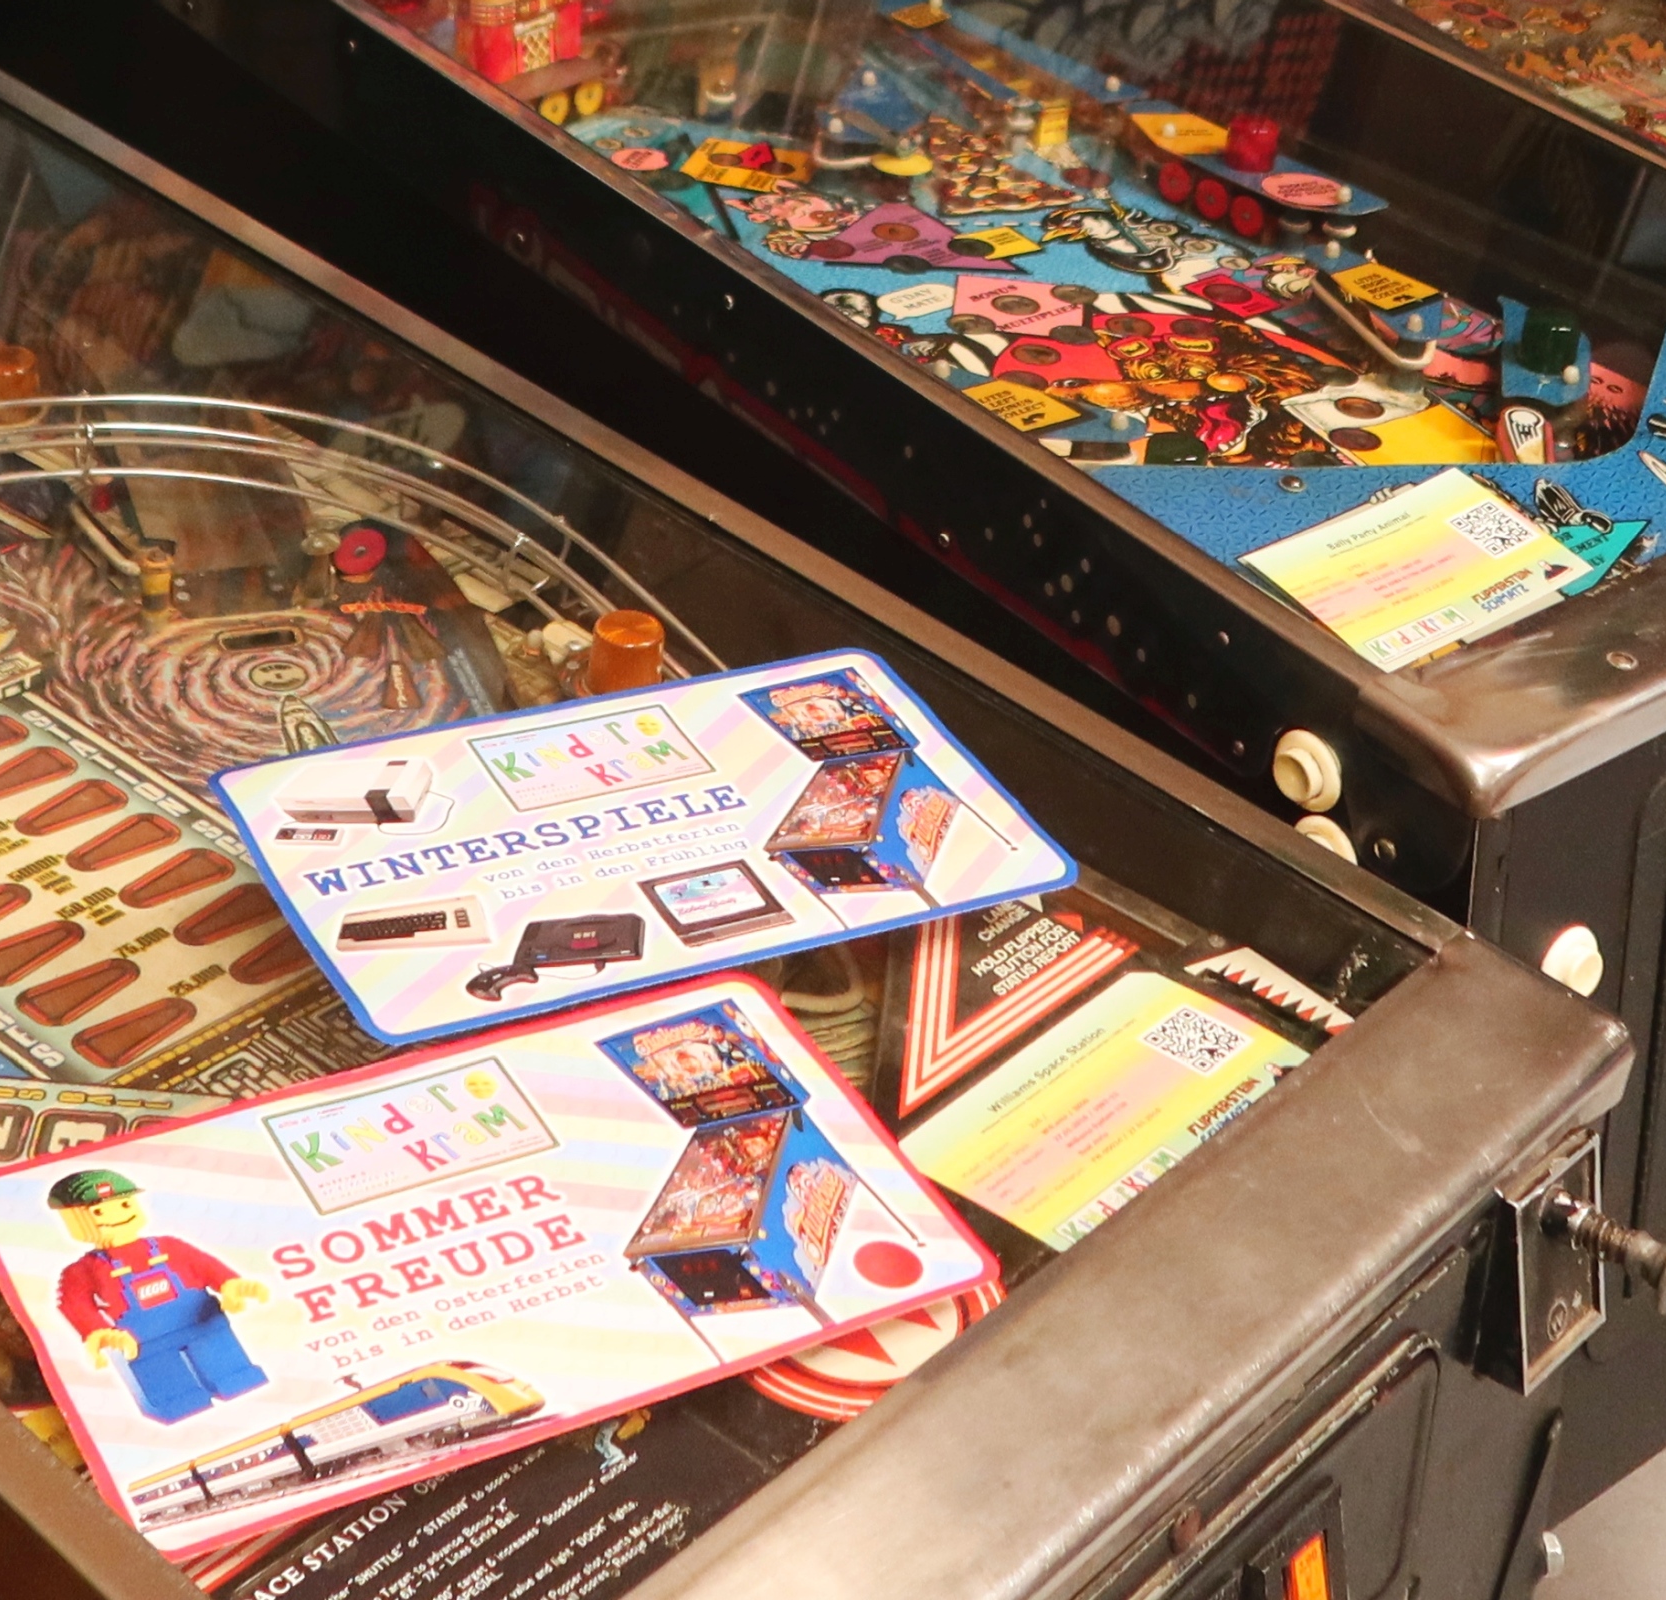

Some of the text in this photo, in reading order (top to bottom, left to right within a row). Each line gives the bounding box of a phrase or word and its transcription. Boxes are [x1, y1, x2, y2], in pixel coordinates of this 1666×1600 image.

[969, 285, 1017, 302] BONUS
[306, 784, 747, 896] WINTERSPIELE
[483, 821, 741, 884] von den Herbstferien
[500, 838, 749, 901] bis in den Frühling
[112, 926, 171, 958] 75,000
[971, 917, 1054, 978] HOLD FLIPPER
[978, 905, 1031, 941] CHANGE
[993, 924, 1069, 979] BUTTON FOR
[167, 963, 226, 998] 25,000
[992, 931, 1081, 996] STATUS REPORT
[58, 1090, 173, 1110] BALL
[272, 1175, 561, 1280] SOMMER
[137, 1278, 170, 1301] LEGO
[294, 1214, 587, 1323] FREUDE
[305, 1253, 606, 1355] von den Osterferien
[333, 1272, 605, 1370] bis in den Herbst
[301, 1489, 408, 1573] STATION
